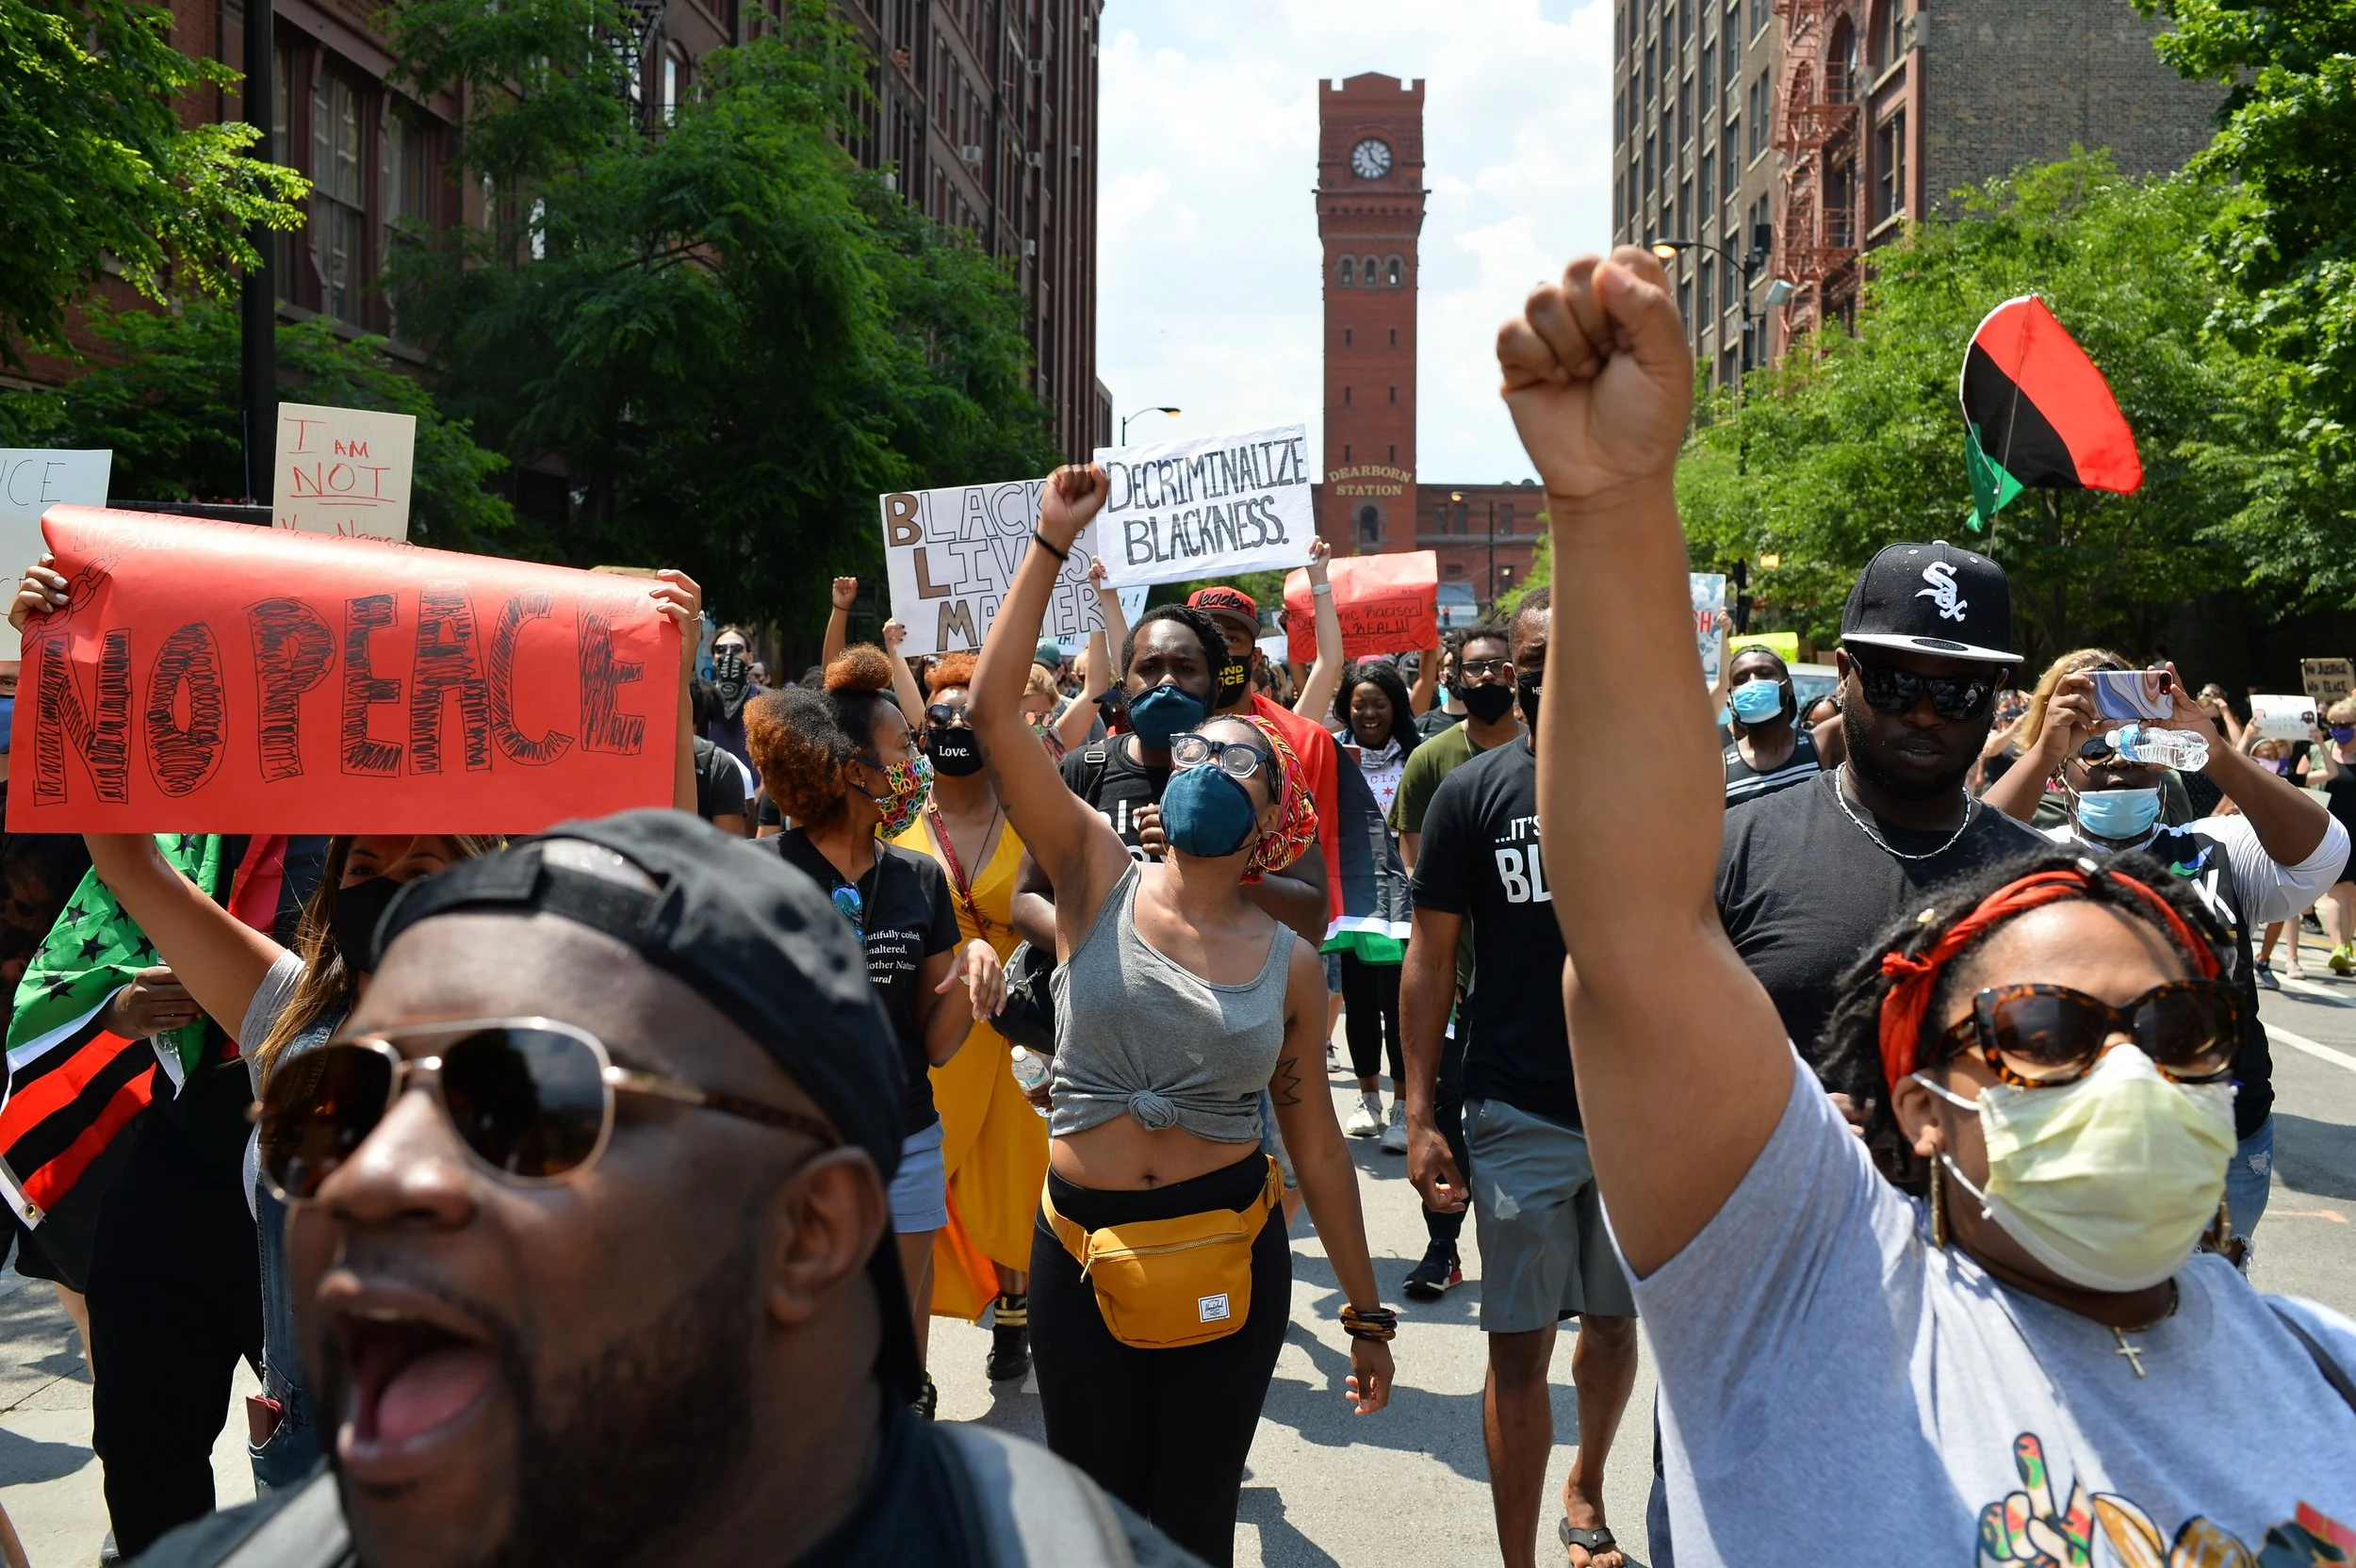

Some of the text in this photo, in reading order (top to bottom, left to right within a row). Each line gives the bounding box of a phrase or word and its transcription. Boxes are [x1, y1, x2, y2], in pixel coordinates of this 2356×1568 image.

[284, 417, 368, 458] I AM
[0, 459, 66, 506] CE
[293, 463, 390, 498] NOT
[1106, 437, 1307, 513] DECRIMINALIZE
[1329, 465, 1412, 482] DEARBORN
[1336, 484, 1402, 496] STATION
[1123, 496, 1289, 565] BLACKNESS.
[913, 529, 1091, 600] LIVS
[937, 581, 1105, 652] MAER
[34, 580, 646, 806] NO PEACE
[939, 745, 970, 757] Love.
[1495, 844, 1553, 903] BL
[867, 930, 899, 940] utifully
[867, 944, 908, 955] naltered,
[866, 960, 894, 970] other
[870, 975, 892, 984] tural
